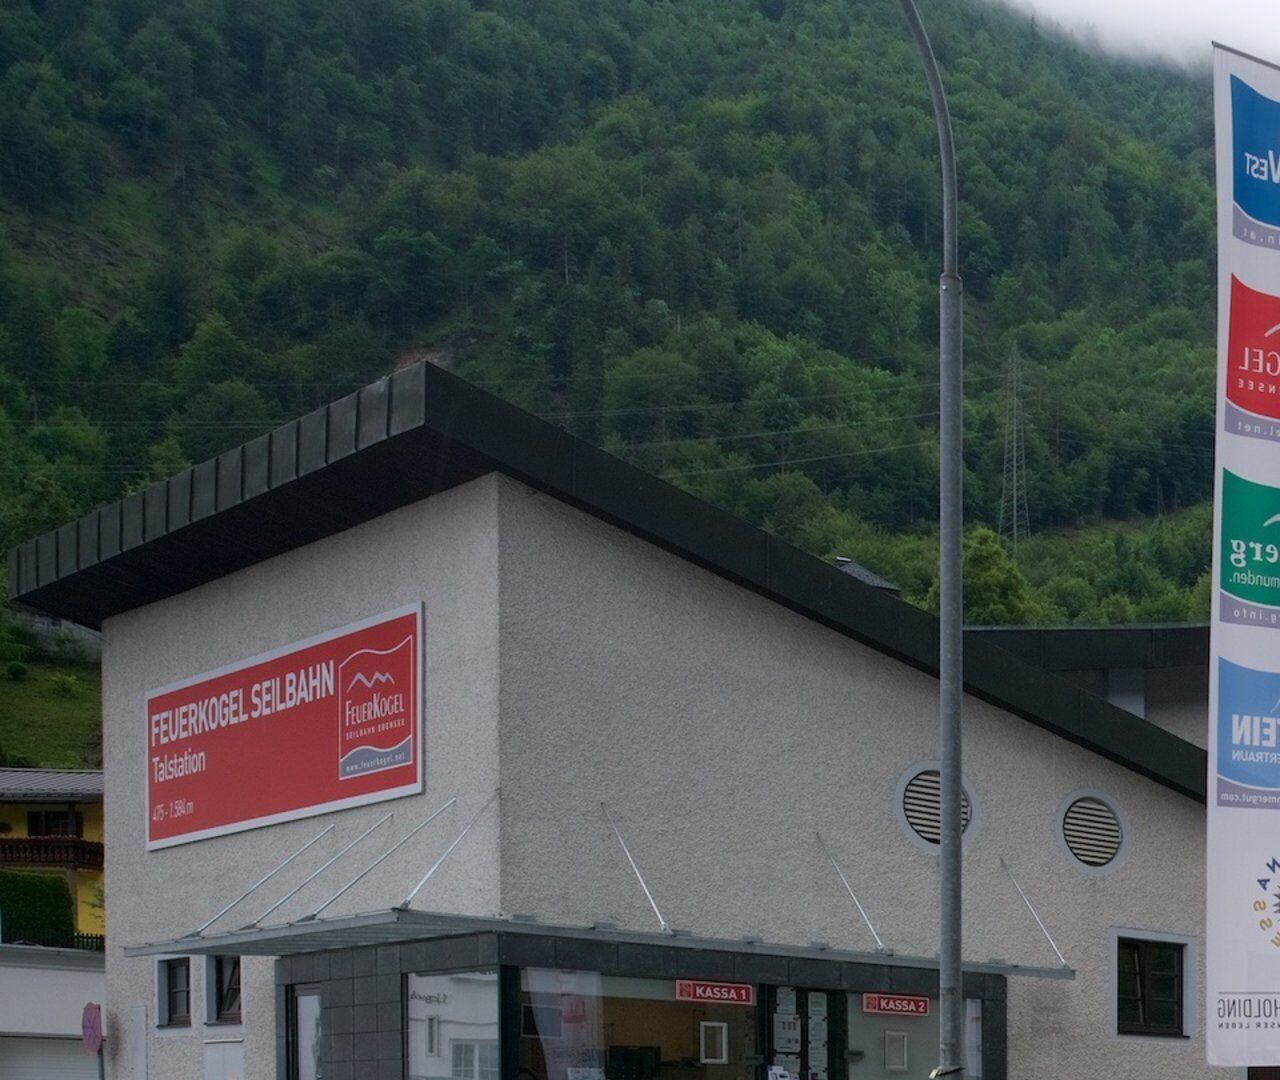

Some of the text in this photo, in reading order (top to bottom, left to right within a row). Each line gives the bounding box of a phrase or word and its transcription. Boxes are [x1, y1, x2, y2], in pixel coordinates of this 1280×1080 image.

[151, 659, 335, 747] FEUERKOGEL SEILBAHN
[152, 748, 206, 783] Talstation
[695, 985, 747, 1000] KASSA 1
[880, 999, 926, 1012] KASSA 2
